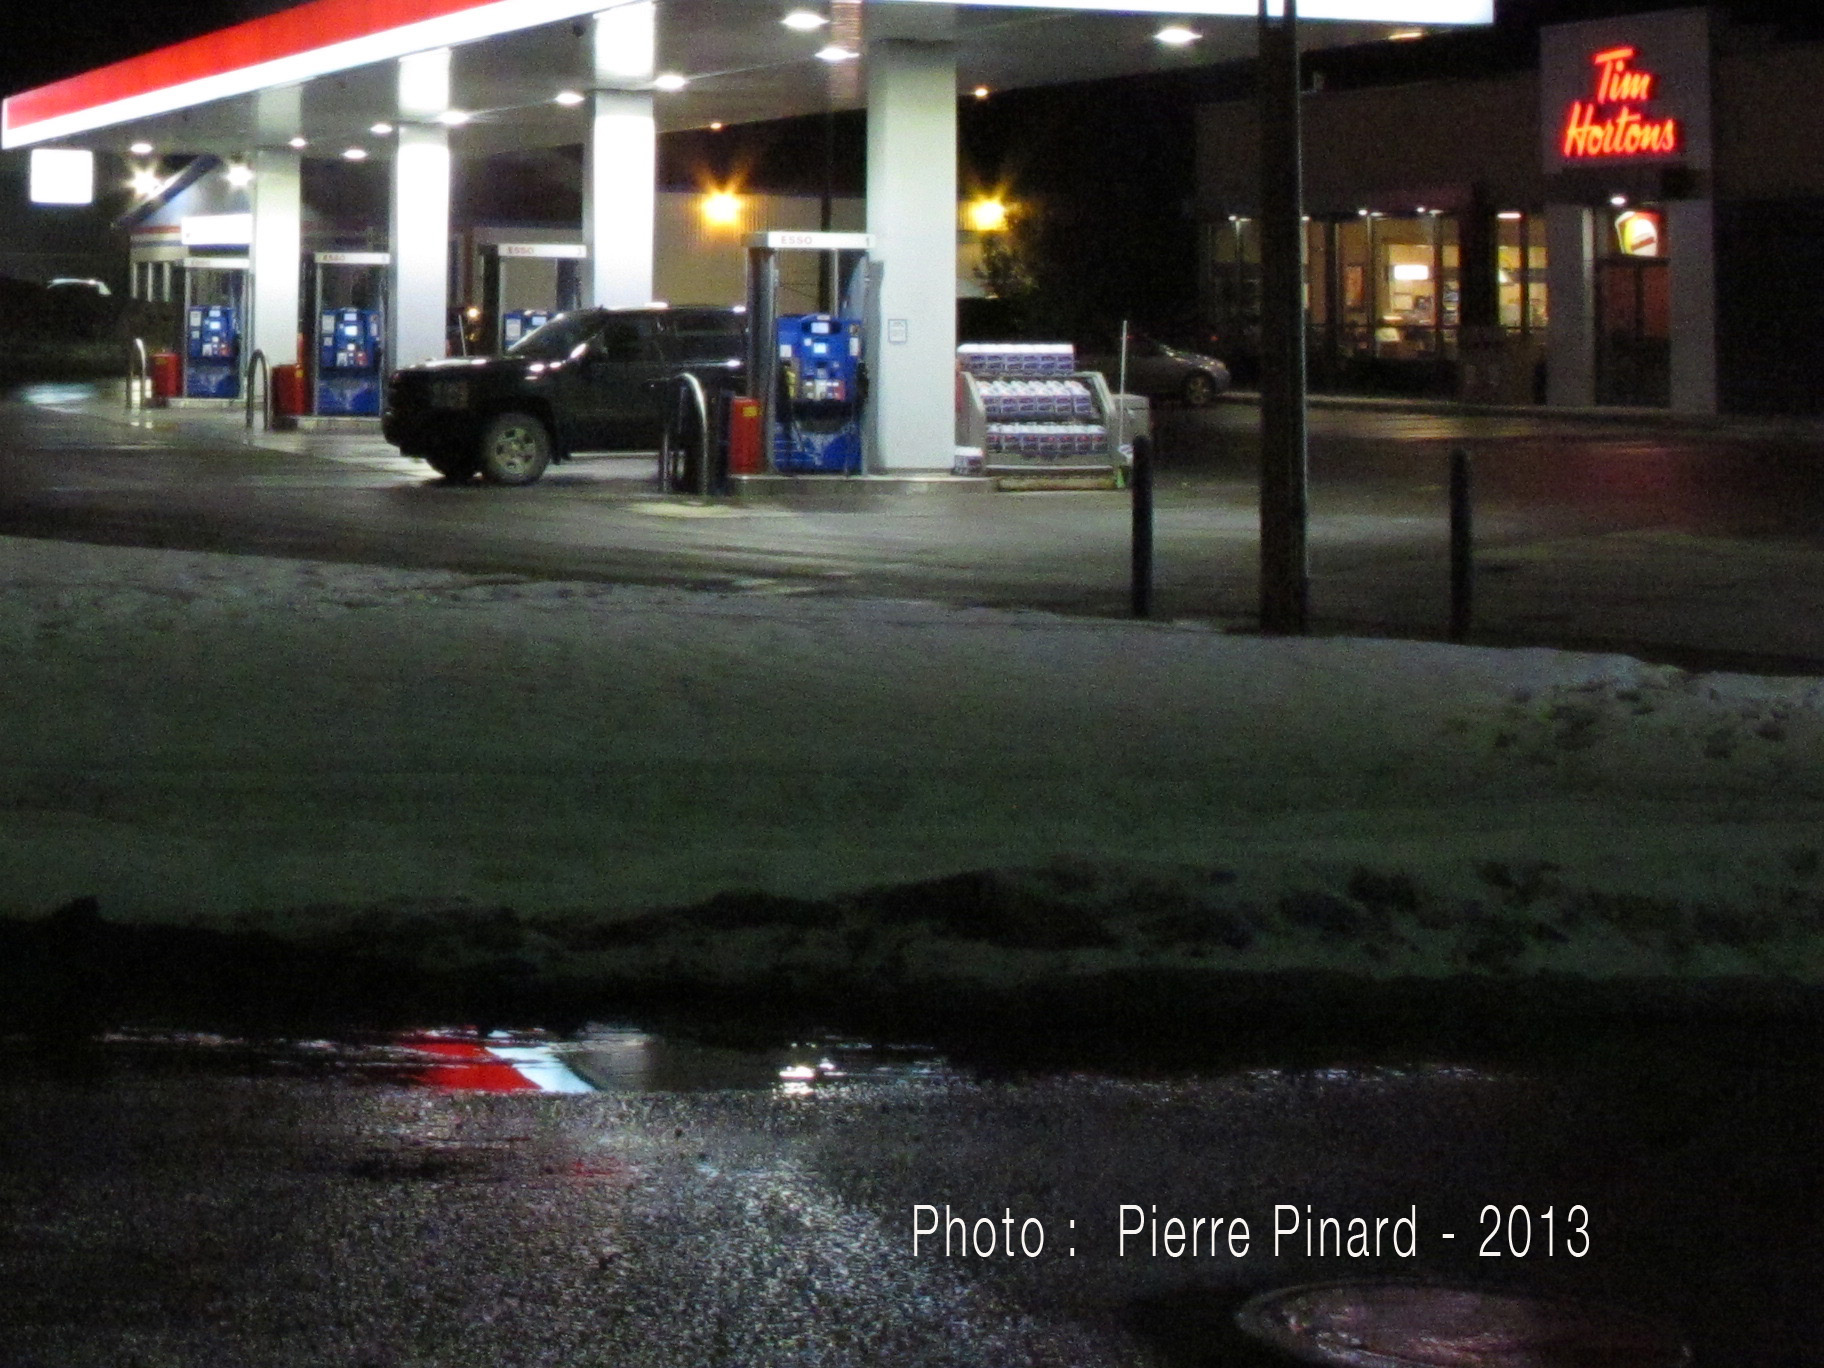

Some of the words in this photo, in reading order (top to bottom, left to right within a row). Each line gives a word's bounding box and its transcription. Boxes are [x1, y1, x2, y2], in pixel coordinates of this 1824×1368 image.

[1594, 46, 1652, 104] Tim
[1562, 100, 1676, 158] Hortons
[780, 235, 813, 245] ESSO
